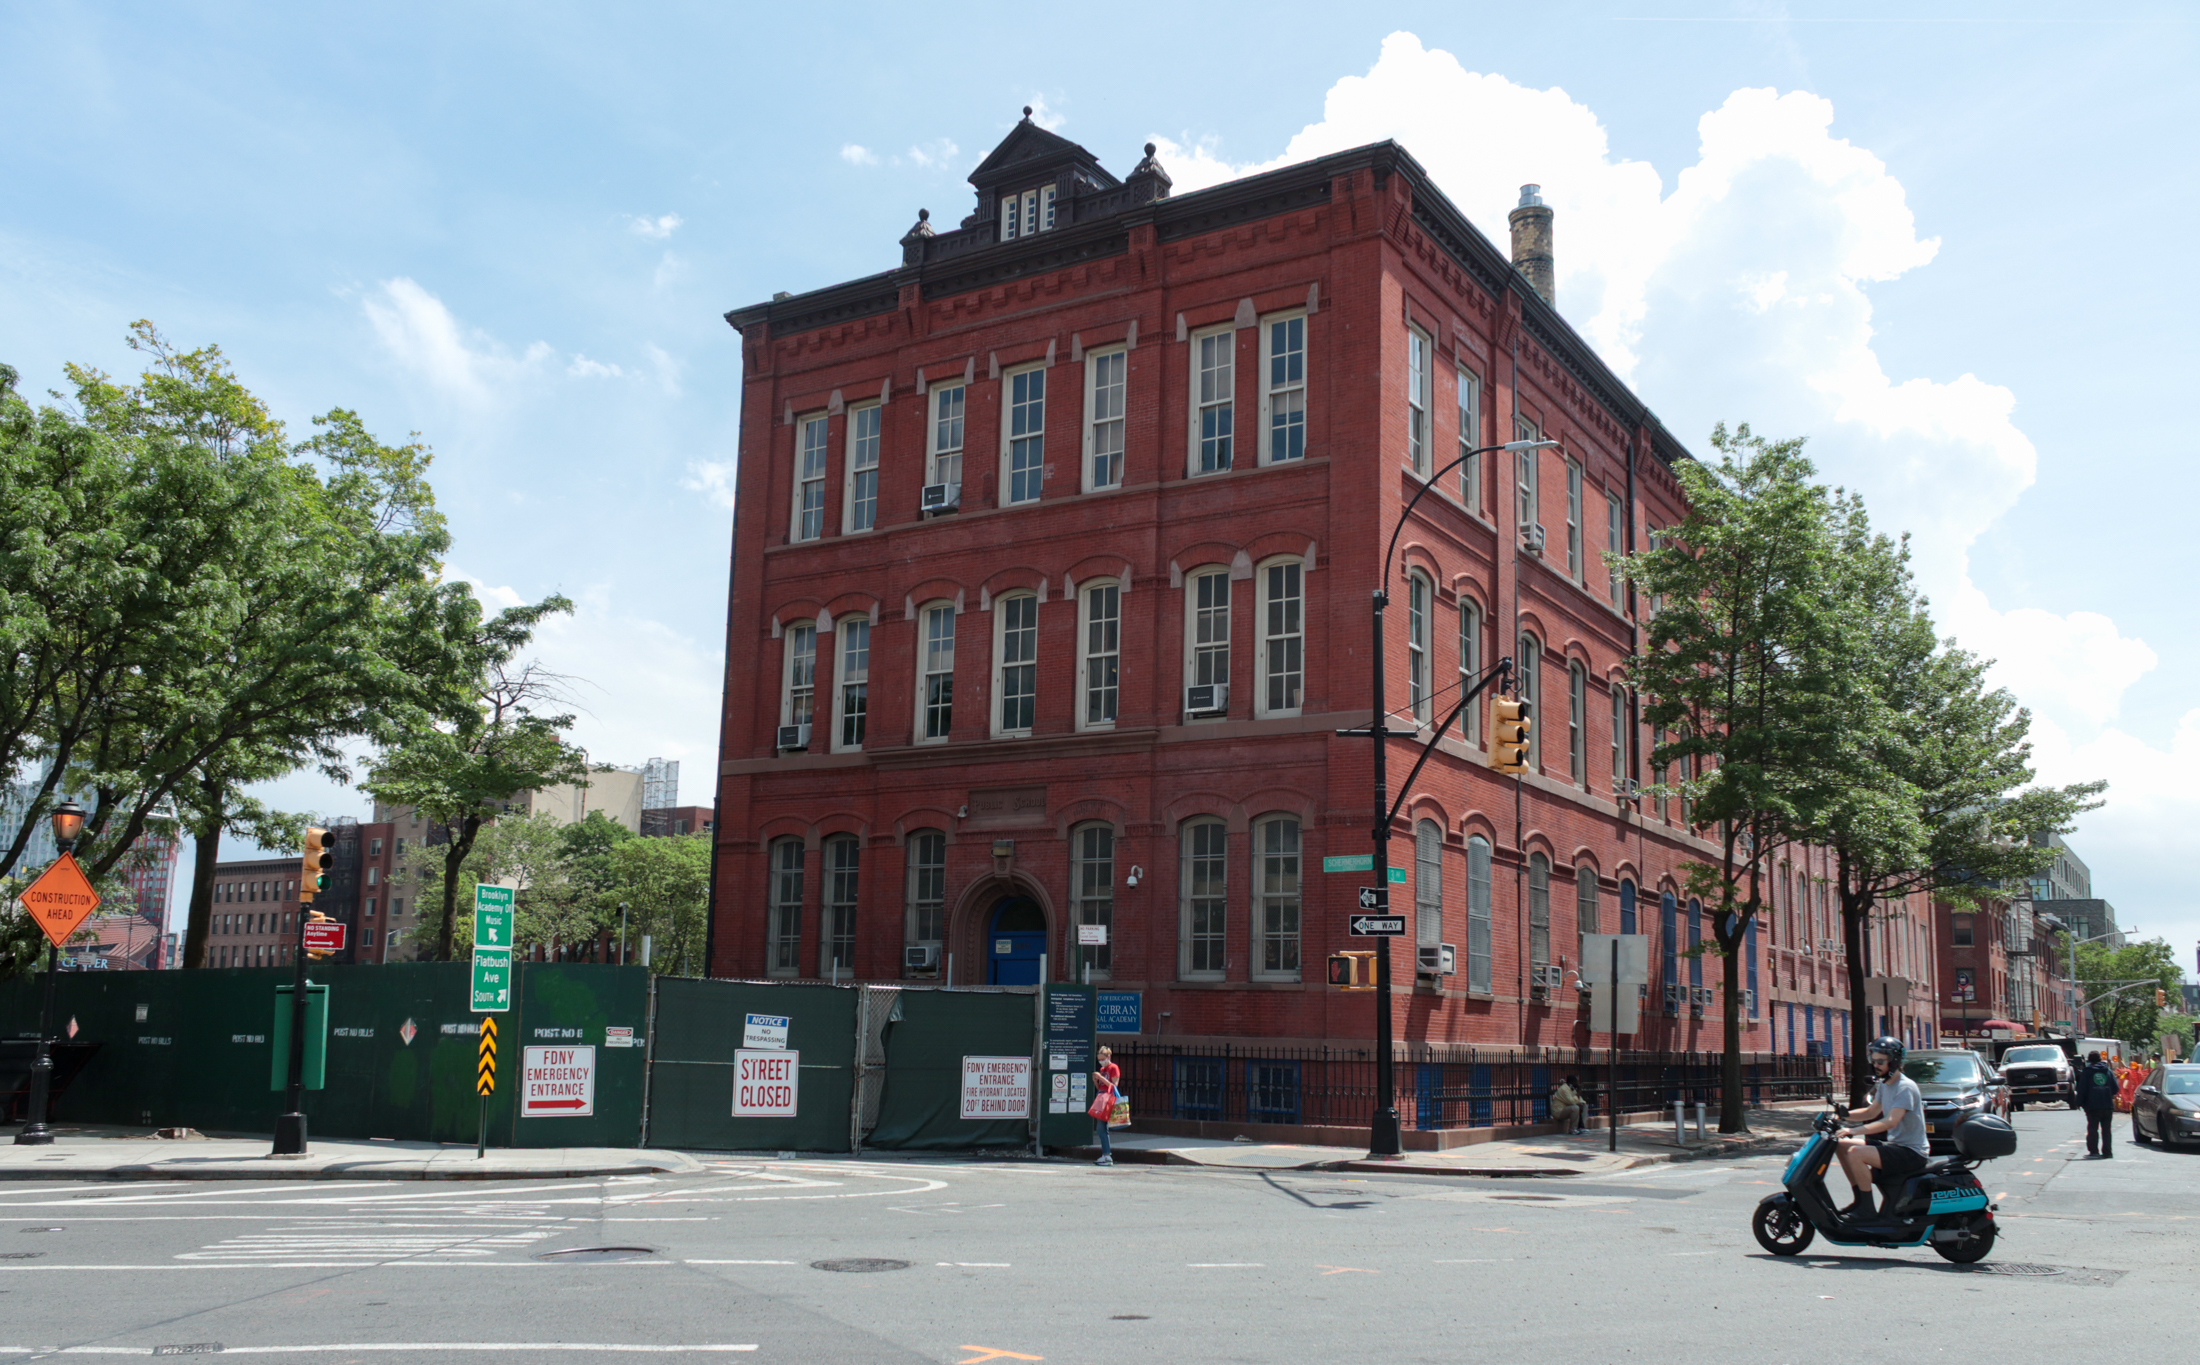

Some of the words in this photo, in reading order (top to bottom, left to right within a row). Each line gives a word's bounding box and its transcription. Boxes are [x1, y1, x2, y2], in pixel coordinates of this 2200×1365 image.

[973, 800, 1003, 814] PUBLIC
[1013, 797, 1046, 811] SCHOOL
[1328, 857, 1372, 868] SCHERMERHORN
[1390, 869, 1395, 881] 3
[31, 892, 91, 906] CONSTRUCTION
[481, 889, 508, 902] Brooklyn
[1363, 894, 1373, 902] ONE
[478, 902, 504, 914] Academy
[46, 909, 73, 920] AHEAD
[485, 915, 502, 925] Music
[1359, 921, 1374, 929] ONE
[1382, 921, 1399, 929] WAY
[61, 956, 109, 970] CEER
[475, 955, 508, 967] Flatbush
[483, 971, 499, 983] Ave
[1099, 1005, 1137, 1015] GIBRAN
[751, 1016, 783, 1027] NOTICE
[334, 1028, 349, 1036] POST
[349, 1028, 358, 1036] NO
[358, 1028, 374, 1037] BILLS
[441, 1023, 457, 1034] POST
[534, 1028, 560, 1038] POST
[561, 1028, 575, 1038] NO
[746, 1034, 786, 1044] TRESPASSING
[543, 1050, 575, 1065] FDNY
[527, 1067, 590, 1081] EMERGENCY
[741, 1058, 791, 1080] STREET
[967, 1062, 985, 1073] FDNY
[987, 1062, 1028, 1074] EMERGENCY
[979, 1074, 1015, 1086] ENTRANCE
[530, 1082, 585, 1096] ENTRANCE
[966, 1087, 978, 1097] FIRE
[979, 1087, 1003, 1097] HYDRANT
[1004, 1087, 1027, 1097] LOCATED
[740, 1085, 791, 1107] CLOSED
[981, 1099, 1006, 1112] BEHIND
[1007, 1099, 1026, 1112] DOOR
[1931, 1187, 1961, 1200] revel
